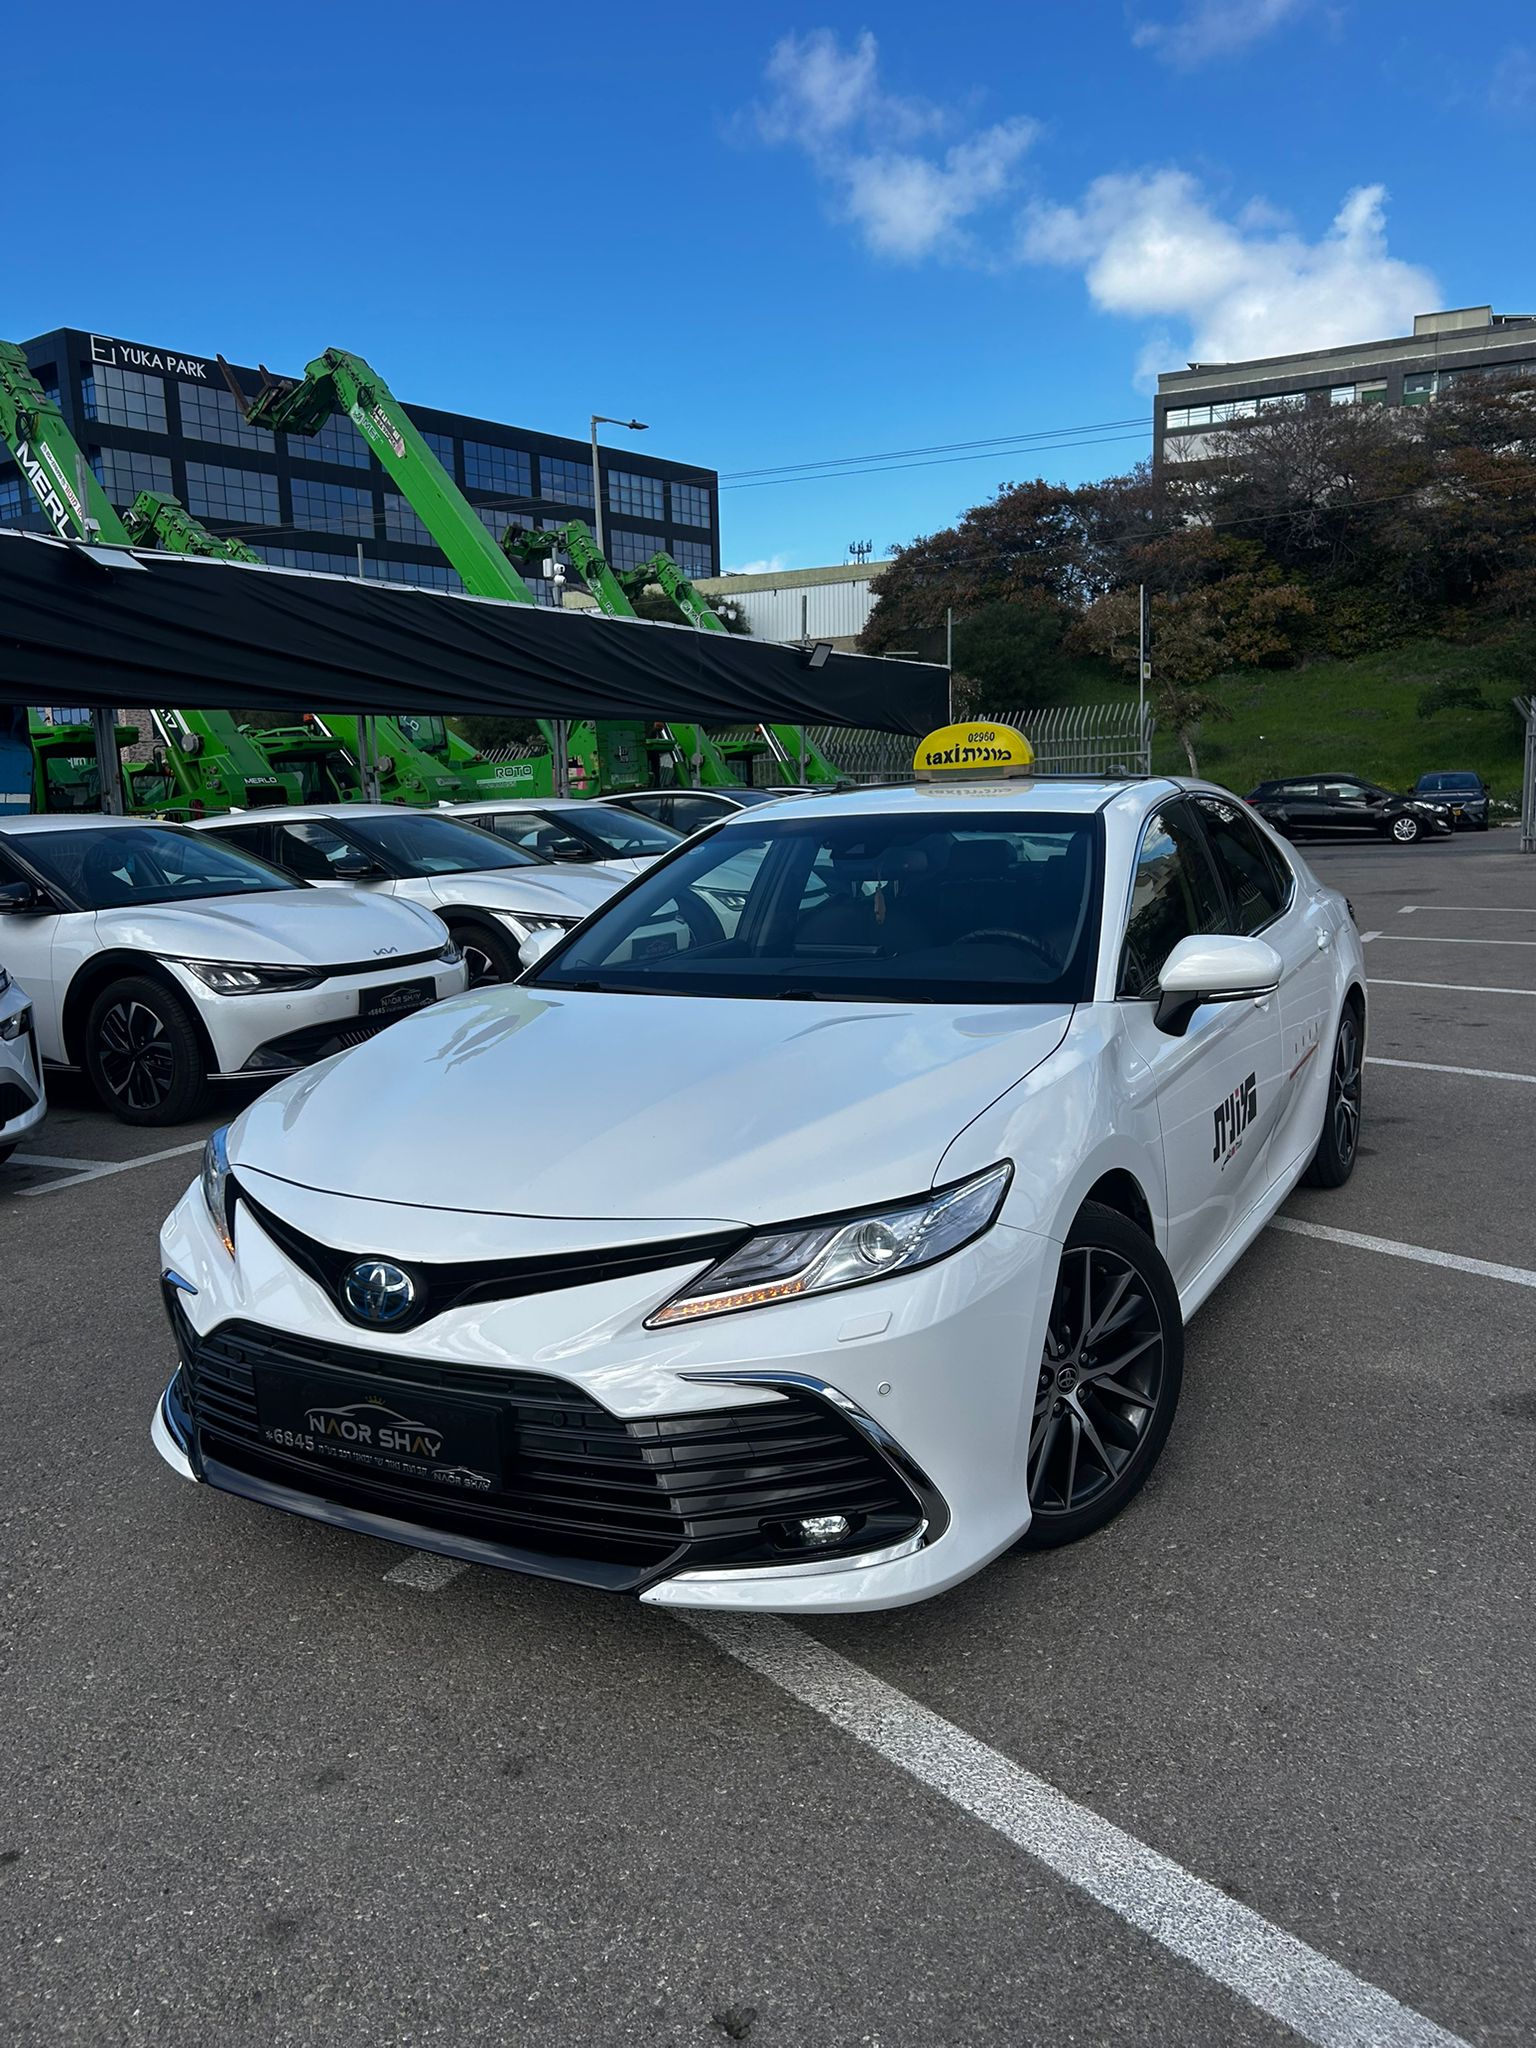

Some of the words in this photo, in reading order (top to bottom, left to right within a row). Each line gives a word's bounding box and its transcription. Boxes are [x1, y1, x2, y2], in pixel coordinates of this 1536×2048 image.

[120, 345, 164, 370] YUKA
[167, 356, 206, 379] PARK
[16, 440, 82, 541] MERL
[967, 731, 996, 743] 02960
[925, 743, 961, 766] taxi
[962, 746, 1012, 762] מונית
[243, 776, 278, 784] MERLO
[495, 765, 533, 778] ROTO
[309, 1414, 373, 1444] NAOR
[379, 1428, 442, 1457] SHAY
